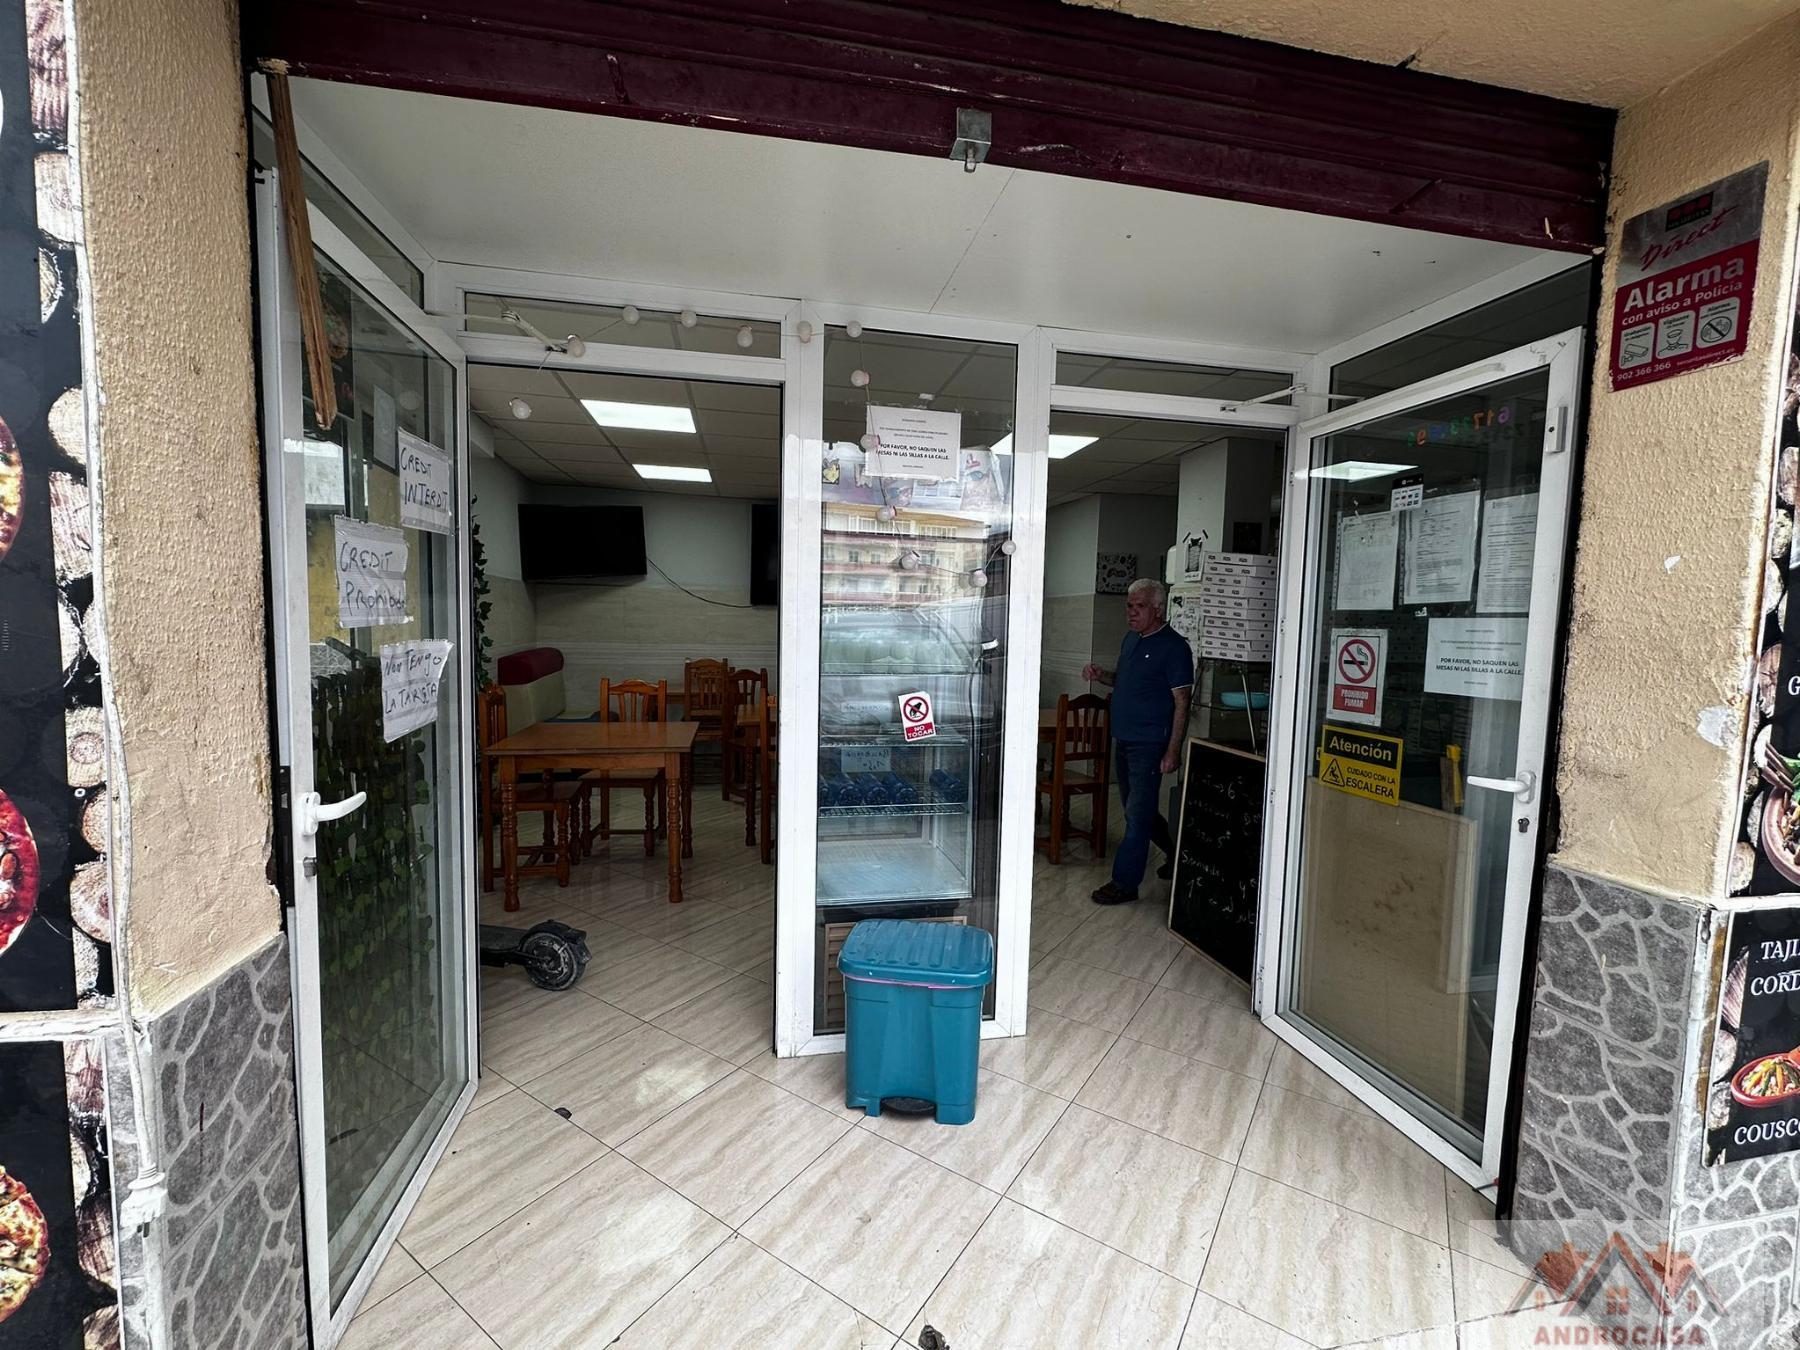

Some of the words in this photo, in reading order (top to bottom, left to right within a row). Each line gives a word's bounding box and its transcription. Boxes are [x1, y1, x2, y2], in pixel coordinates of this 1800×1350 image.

[1623, 257, 1745, 313] Alarma
[1622, 312, 1643, 326] con
[1646, 300, 1680, 318] aviso
[1682, 297, 1692, 306] a
[1617, 373, 1634, 381] 902
[1635, 367, 1653, 377] 366
[1654, 361, 1672, 373] 366
[1482, 659, 1507, 667] SAQUEN
[907, 728, 933, 738] TOCAR
[1329, 736, 1392, 761] Atención
[1346, 766, 1372, 778] CUIDADO
[1373, 773, 1387, 782] CON
[1387, 776, 1396, 785] LA
[1346, 777, 1395, 799] ESCALERA
[1760, 938, 1800, 962] TAJI
[1734, 1118, 1800, 1145] COUSC
